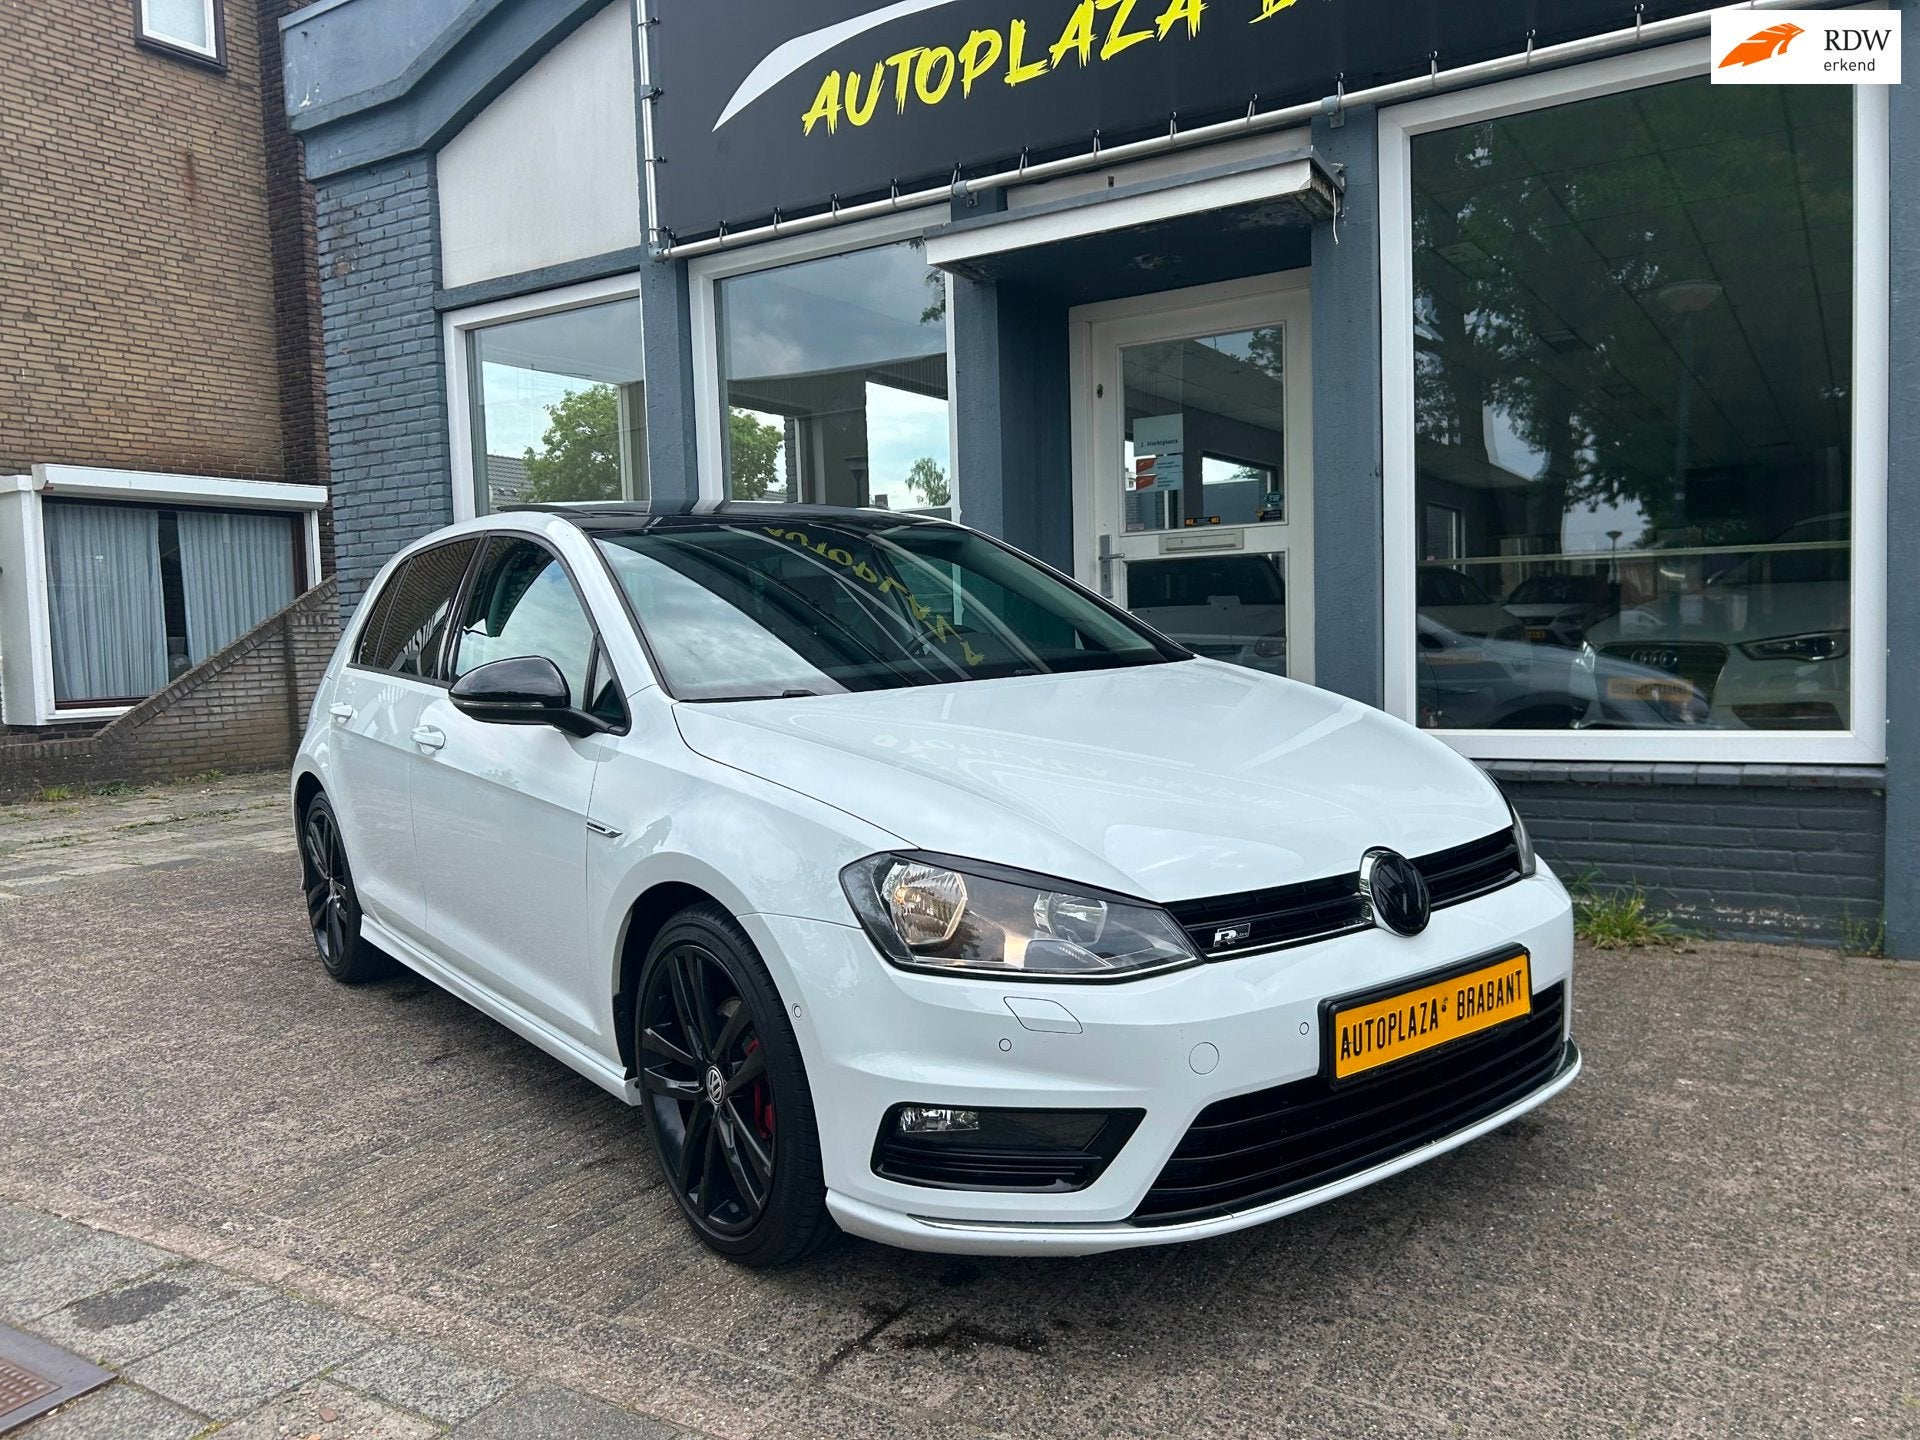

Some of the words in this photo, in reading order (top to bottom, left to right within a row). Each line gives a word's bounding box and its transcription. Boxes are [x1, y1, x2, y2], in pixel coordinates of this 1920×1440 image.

[802, 0, 1208, 136] AUTOPLAZA
[1340, 998, 1439, 1061] AUTOPLAZA
[1456, 969, 1523, 1022] BRABANT
